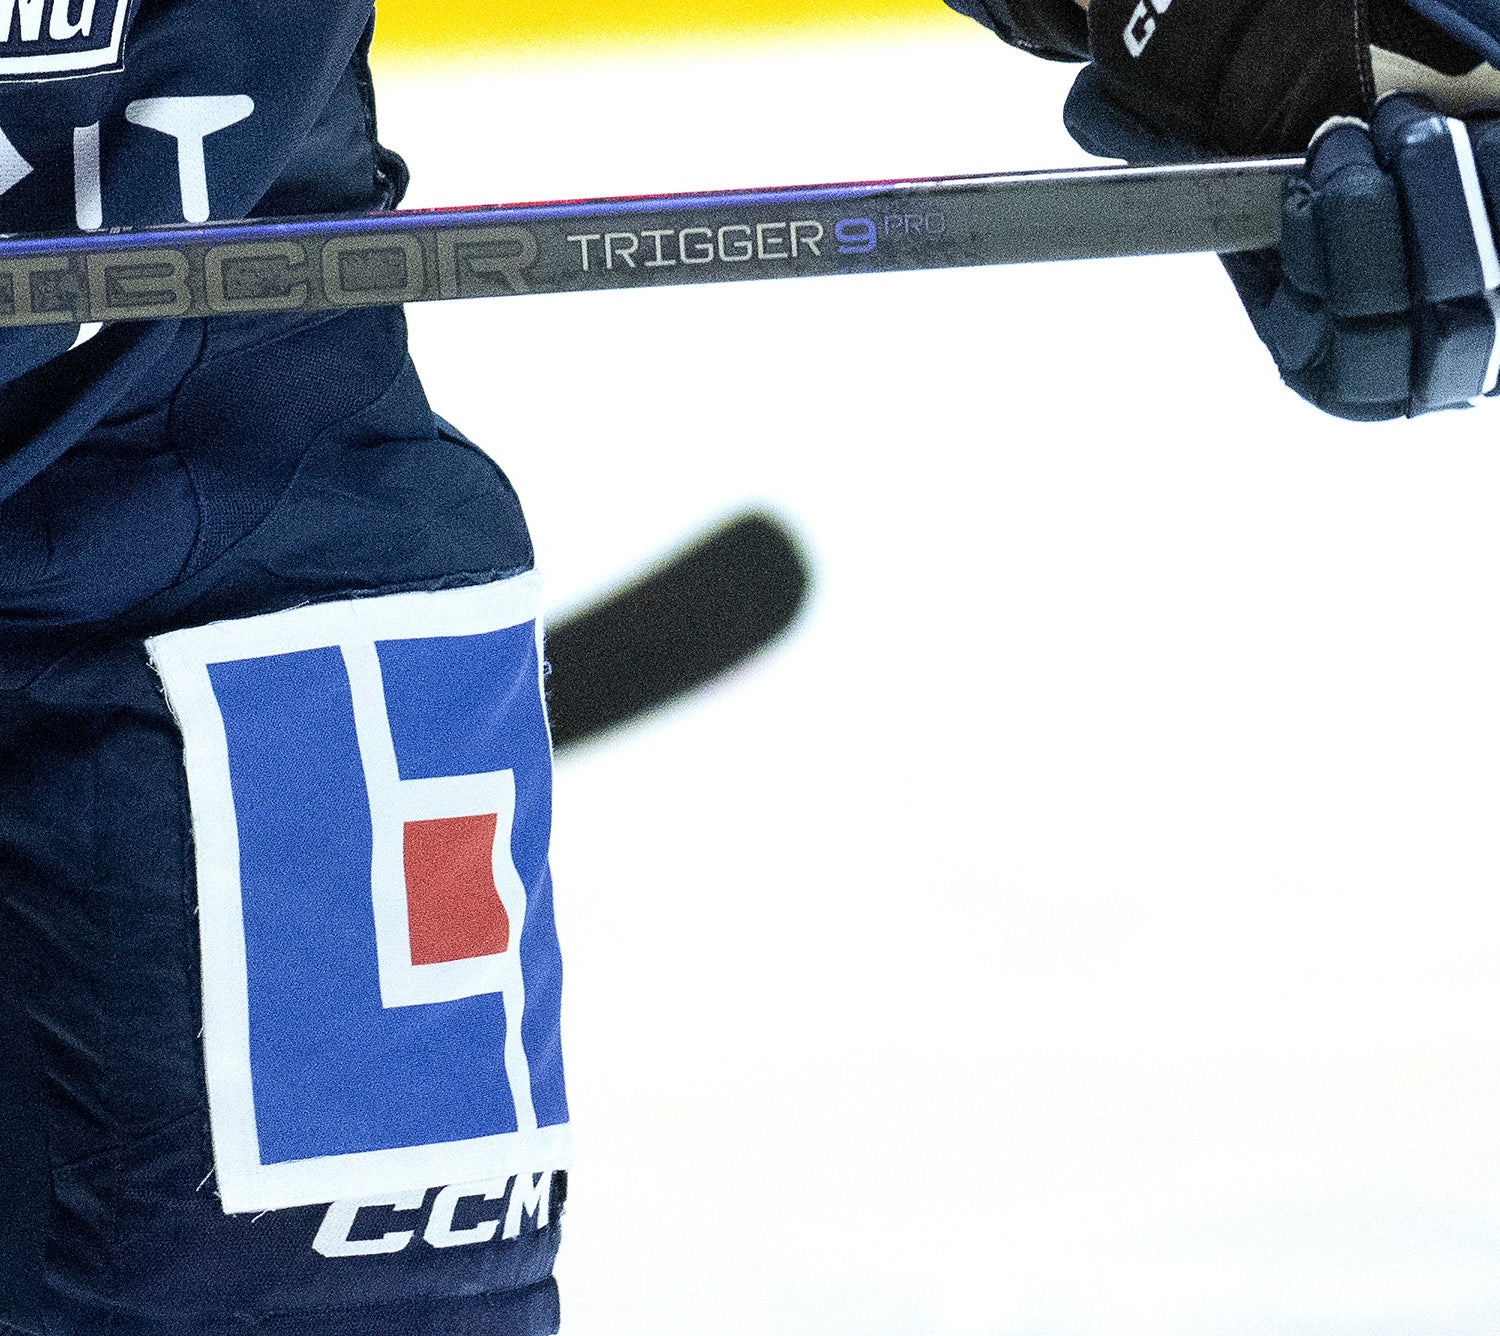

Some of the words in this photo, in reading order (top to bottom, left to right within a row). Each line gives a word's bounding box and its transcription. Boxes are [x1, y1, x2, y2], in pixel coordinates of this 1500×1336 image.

[566, 219, 825, 273] TRIGGER
[834, 216, 877, 254] 9
[310, 1171, 551, 1259] CCM
